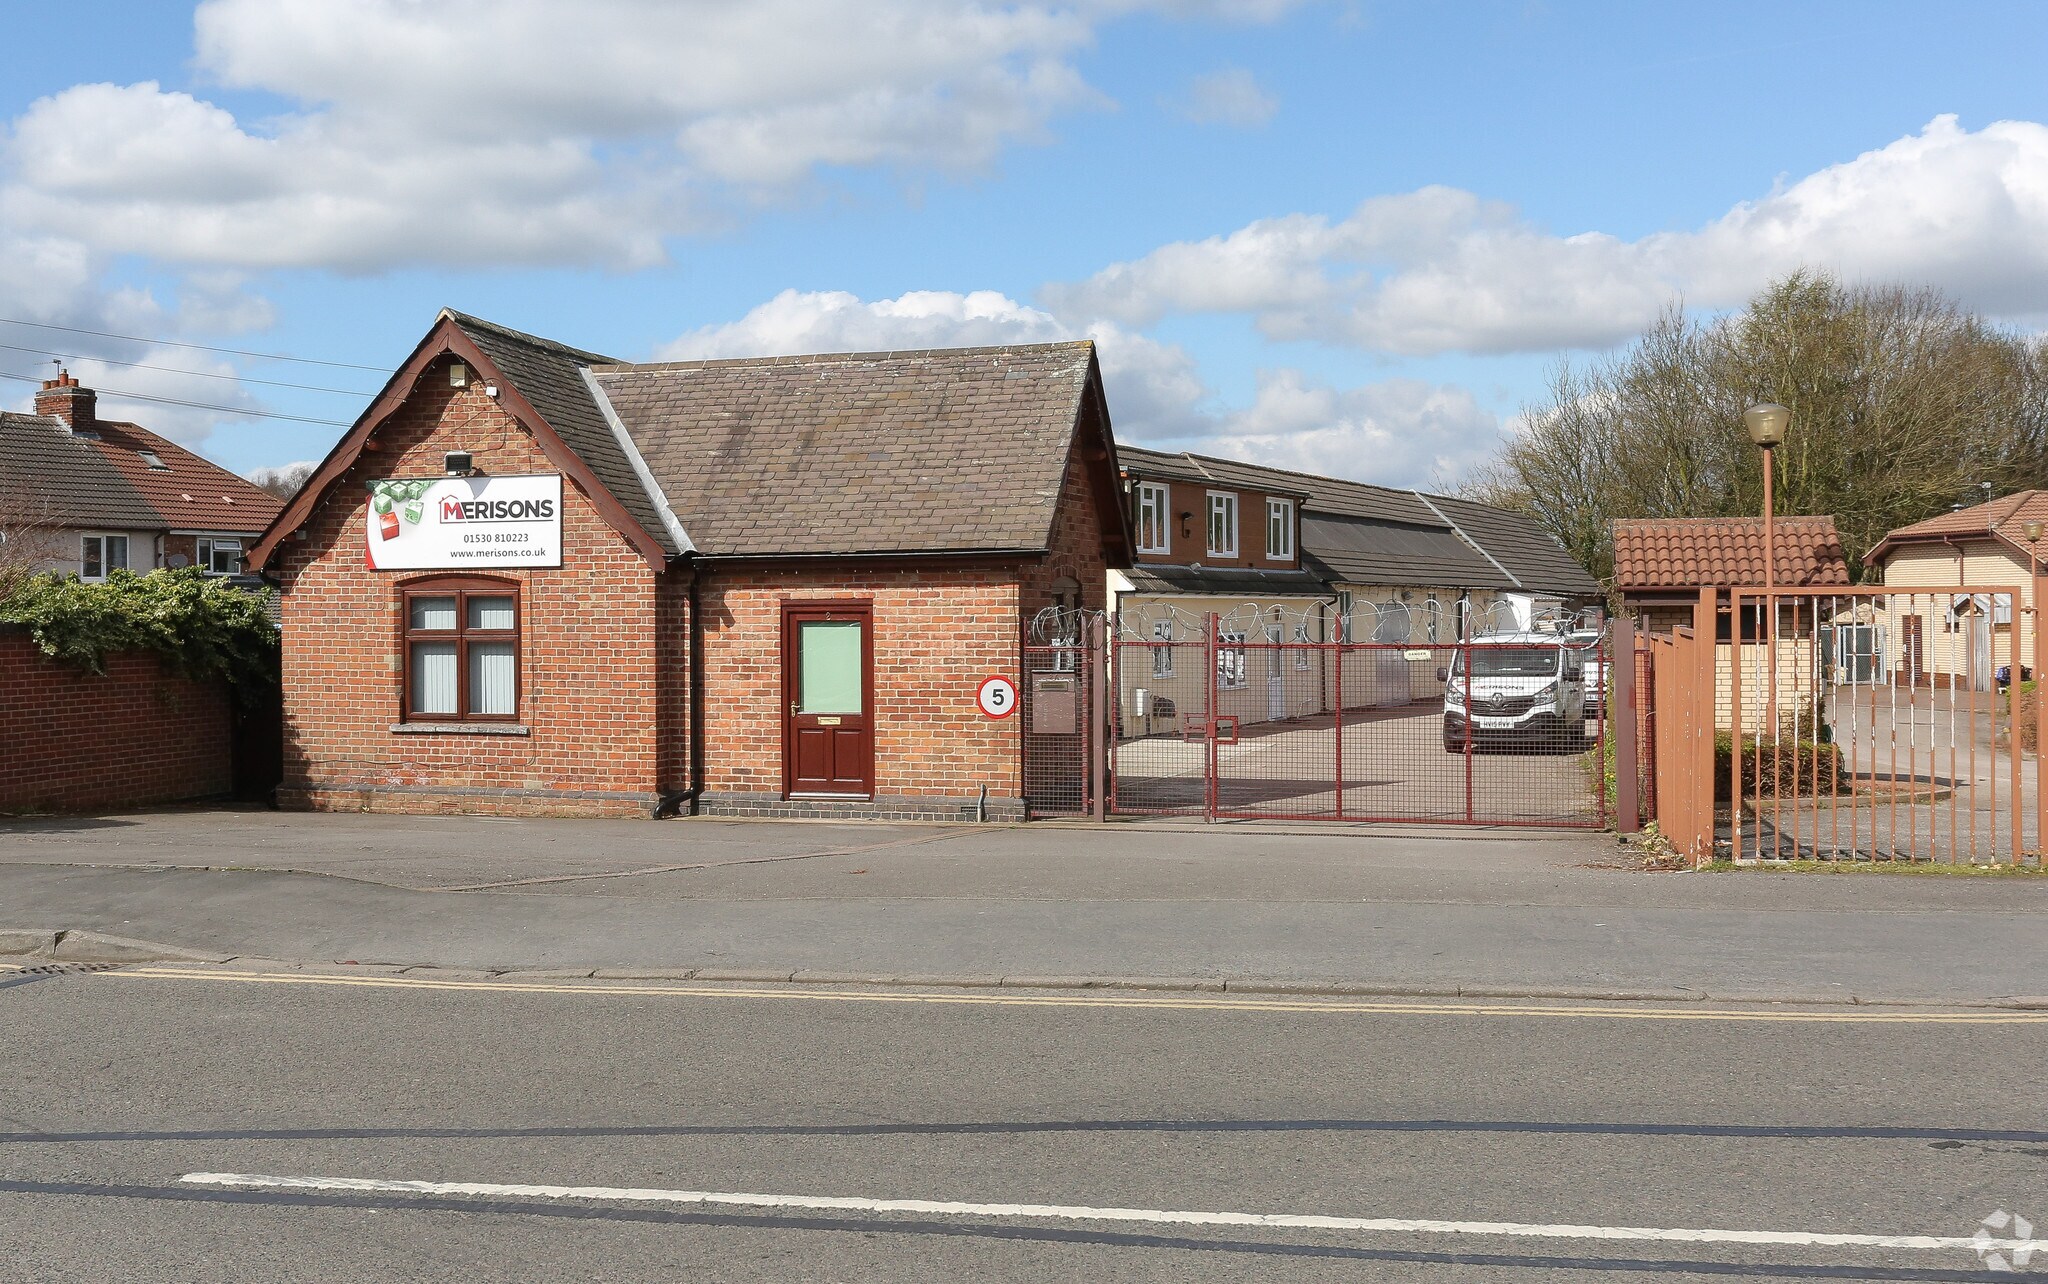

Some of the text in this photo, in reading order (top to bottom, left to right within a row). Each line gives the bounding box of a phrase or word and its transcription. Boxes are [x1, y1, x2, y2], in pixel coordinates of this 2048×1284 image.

[444, 499, 554, 520] MERISONS
[463, 533, 529, 543] 01530 810223
[450, 547, 546, 558] www.merisons.co.uk
[825, 611, 831, 621] 2
[992, 688, 1005, 706] 5
